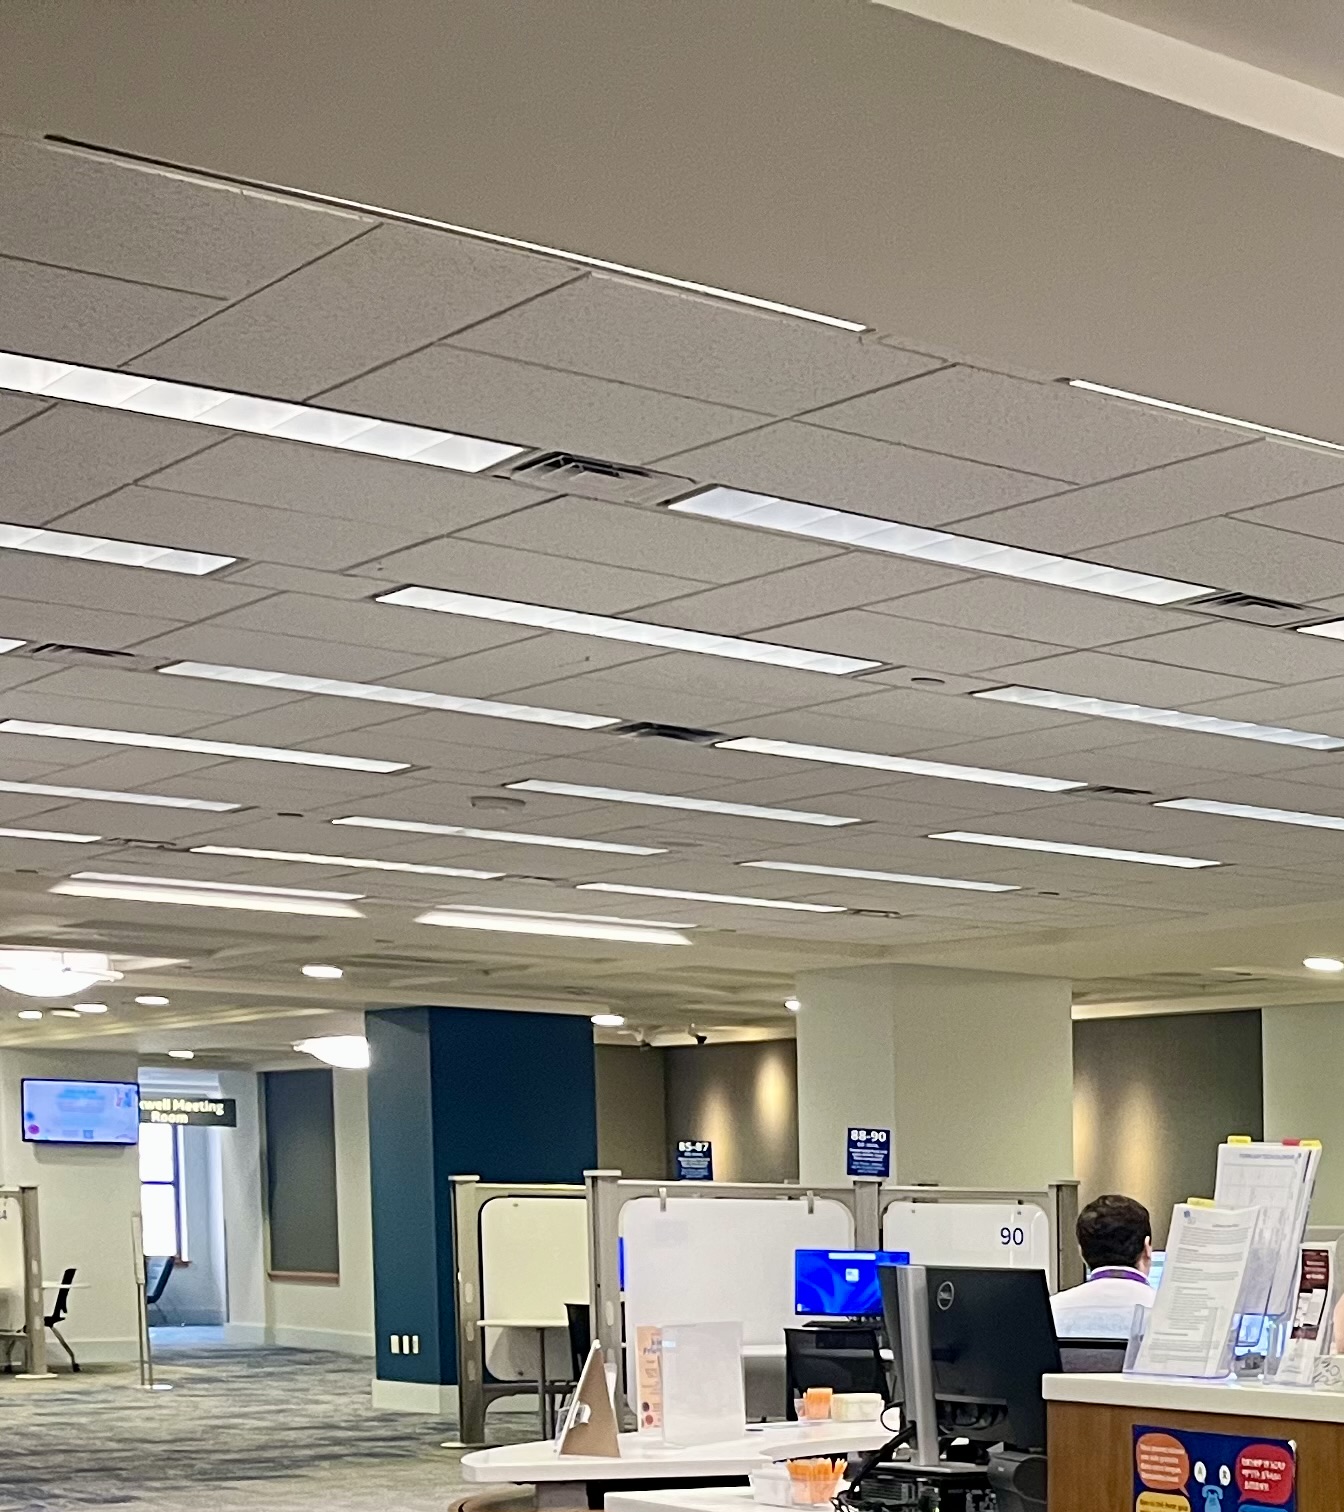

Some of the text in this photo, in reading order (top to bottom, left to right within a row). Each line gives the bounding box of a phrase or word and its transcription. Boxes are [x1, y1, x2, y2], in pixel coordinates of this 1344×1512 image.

[173, 1099, 224, 1115] Meeting
[151, 1111, 188, 1123] Room
[851, 1130, 887, 1142] 88-90
[1000, 1227, 1024, 1246] 90
